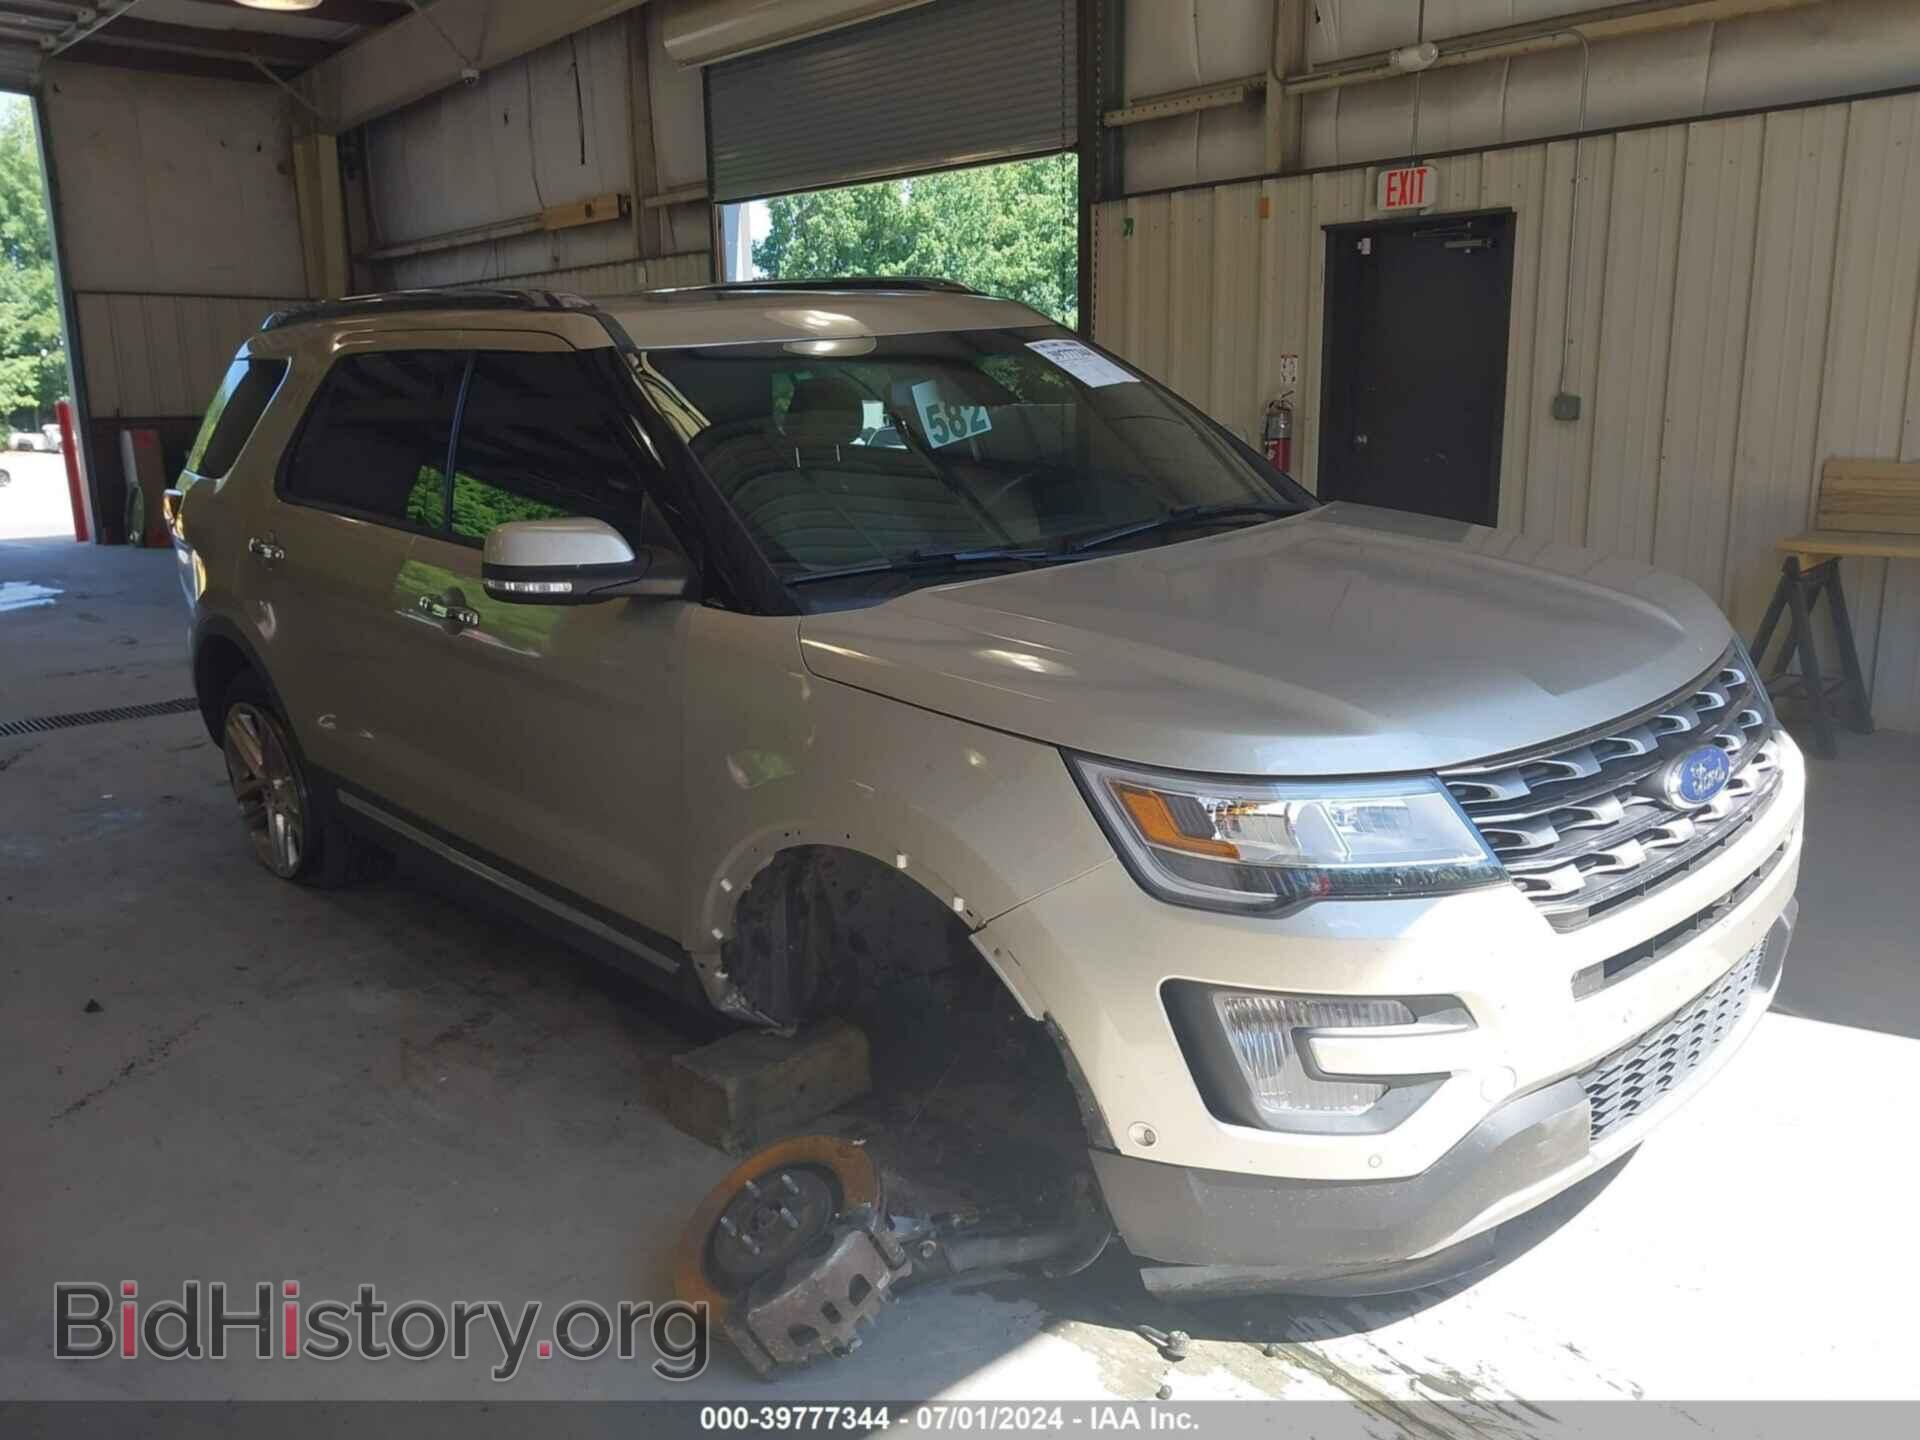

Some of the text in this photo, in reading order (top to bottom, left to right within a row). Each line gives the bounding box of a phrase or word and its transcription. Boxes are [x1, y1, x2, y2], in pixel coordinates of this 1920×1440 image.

[1386, 168, 1427, 207] EXIT
[925, 400, 988, 444] 582
[1690, 758, 1726, 798] Ford
